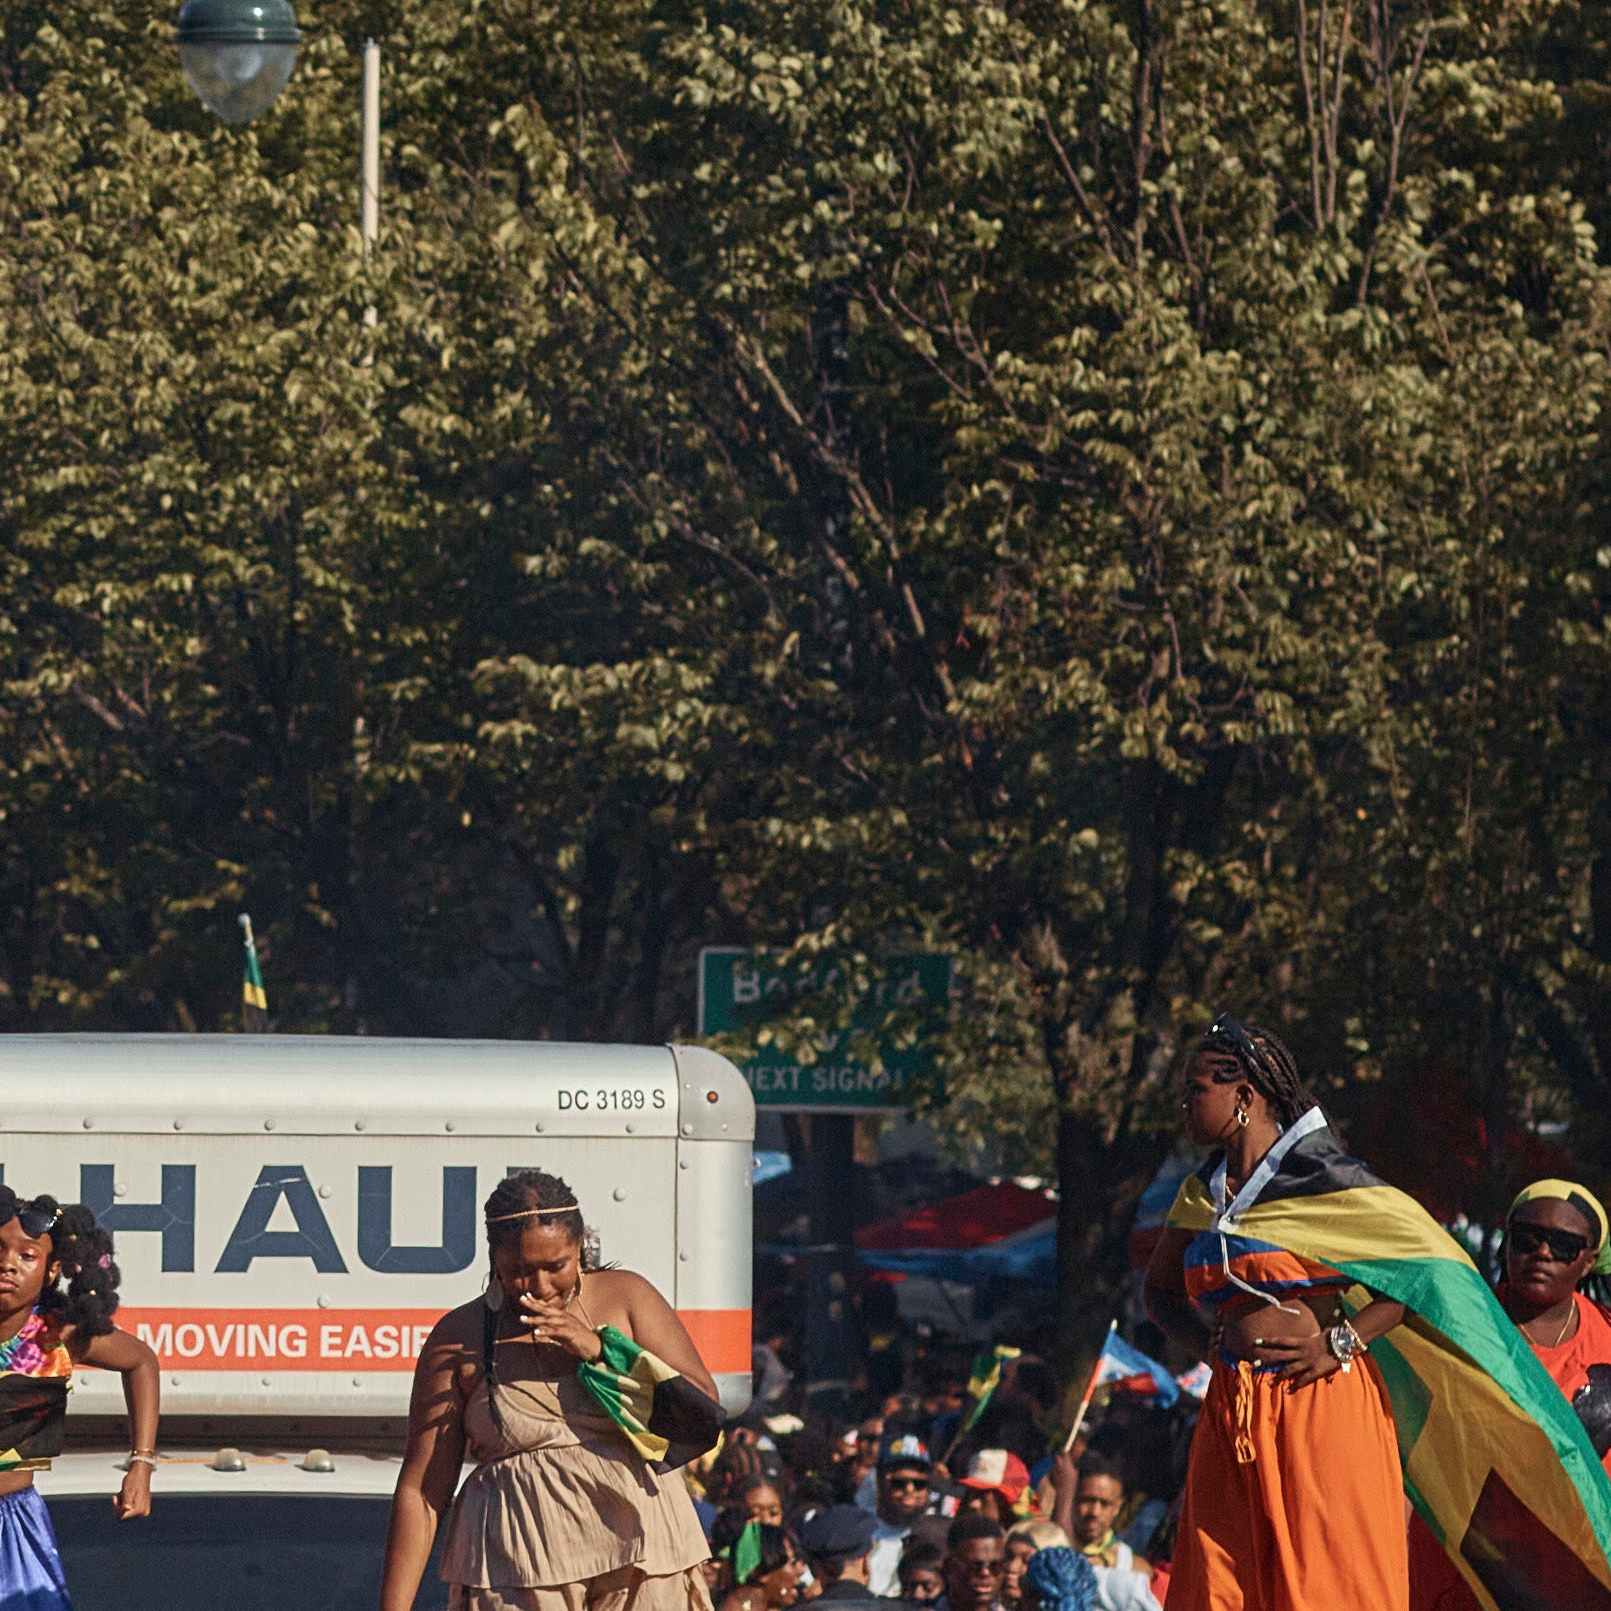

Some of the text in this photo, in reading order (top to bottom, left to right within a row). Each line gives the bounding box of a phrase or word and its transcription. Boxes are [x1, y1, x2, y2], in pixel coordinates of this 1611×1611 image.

[558, 1088, 666, 1110] DC 3189 S
[136, 1323, 308, 1358] MOVING
